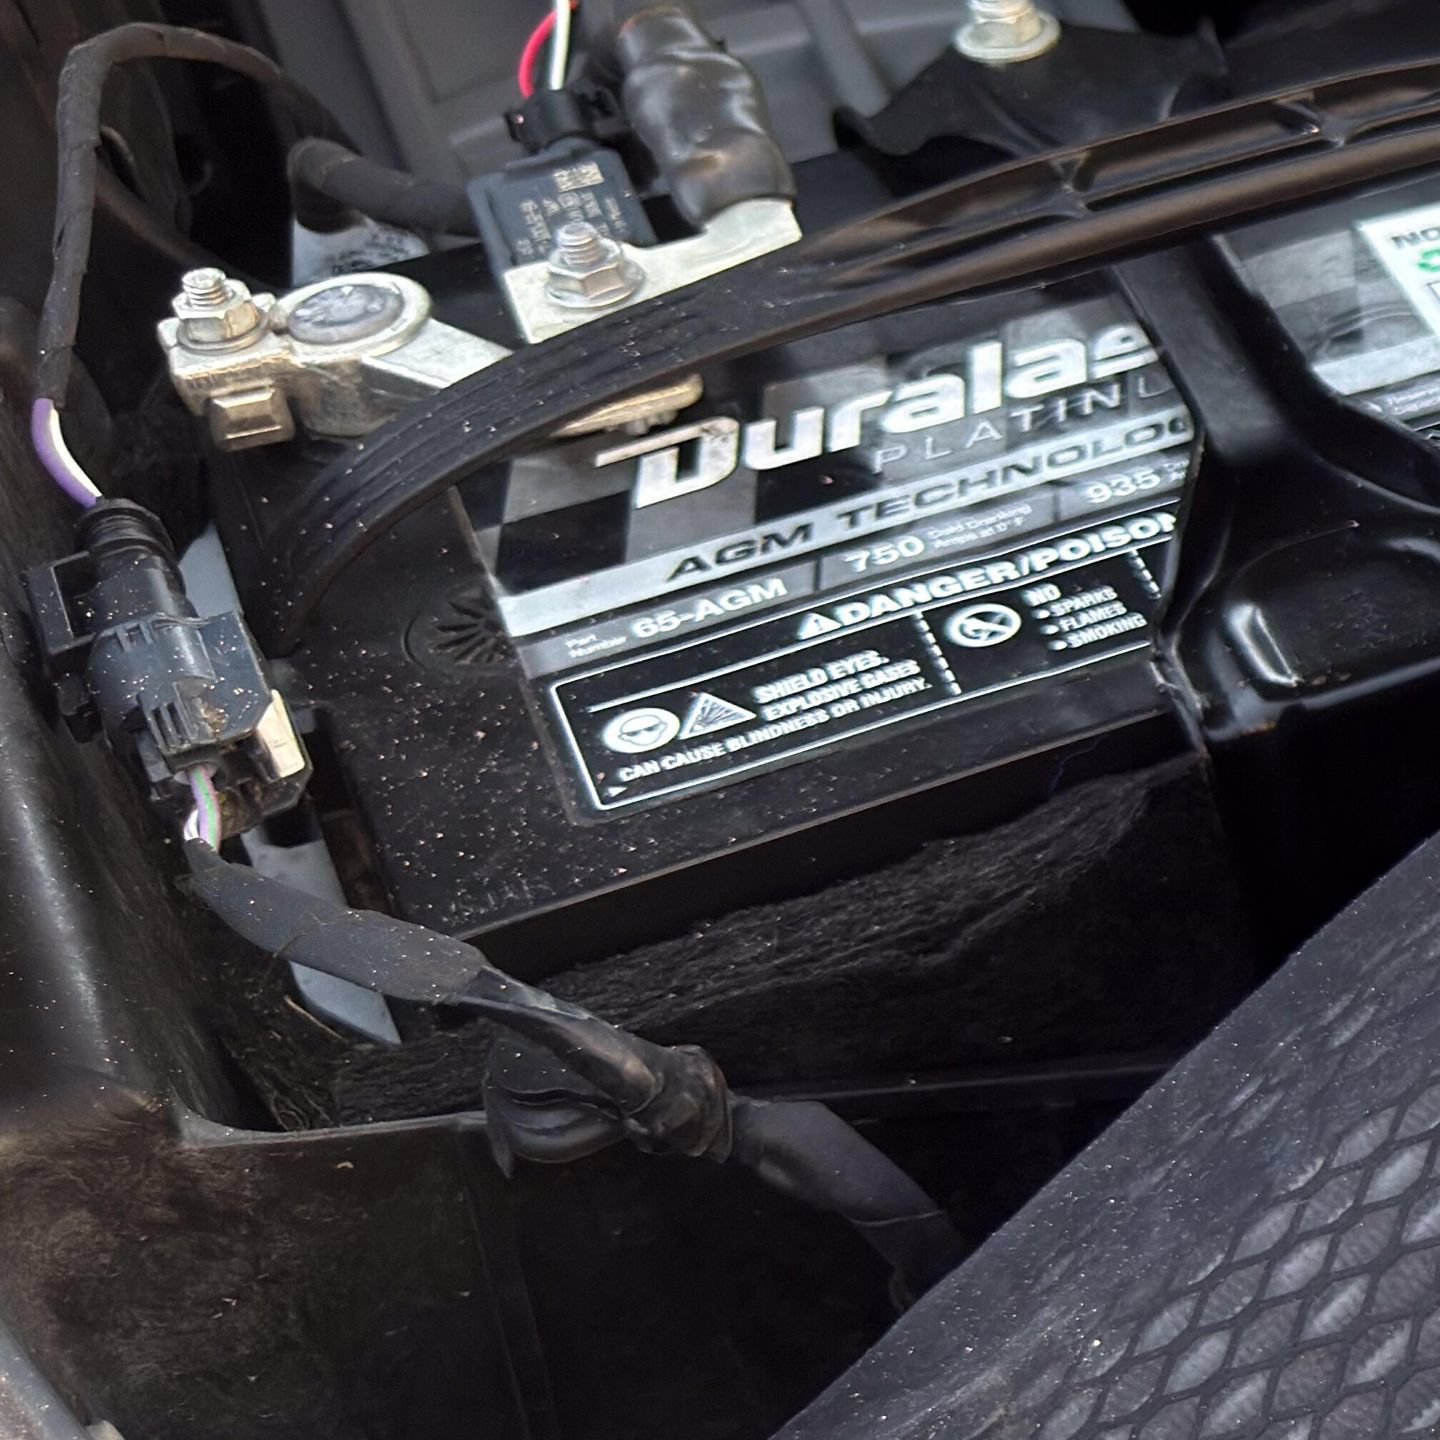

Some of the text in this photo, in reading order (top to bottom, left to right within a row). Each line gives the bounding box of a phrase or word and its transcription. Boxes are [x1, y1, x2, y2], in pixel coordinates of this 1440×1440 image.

[844, 535, 926, 574] 750
[1086, 465, 1161, 504] 935
[666, 521, 814, 582] AGM
[631, 577, 788, 640] 65-AGM
[1022, 583, 1062, 607] NO
[1058, 600, 1128, 632] FLAMES
[1066, 612, 1148, 648] SMOKING
[753, 666, 828, 705] SHIELD
[764, 658, 922, 723] EXPLOSIVE GASES
[617, 759, 661, 783] CAN
[662, 741, 725, 771] CAUSE
[726, 708, 830, 752] BLINDNESS
[831, 699, 860, 719] OR
